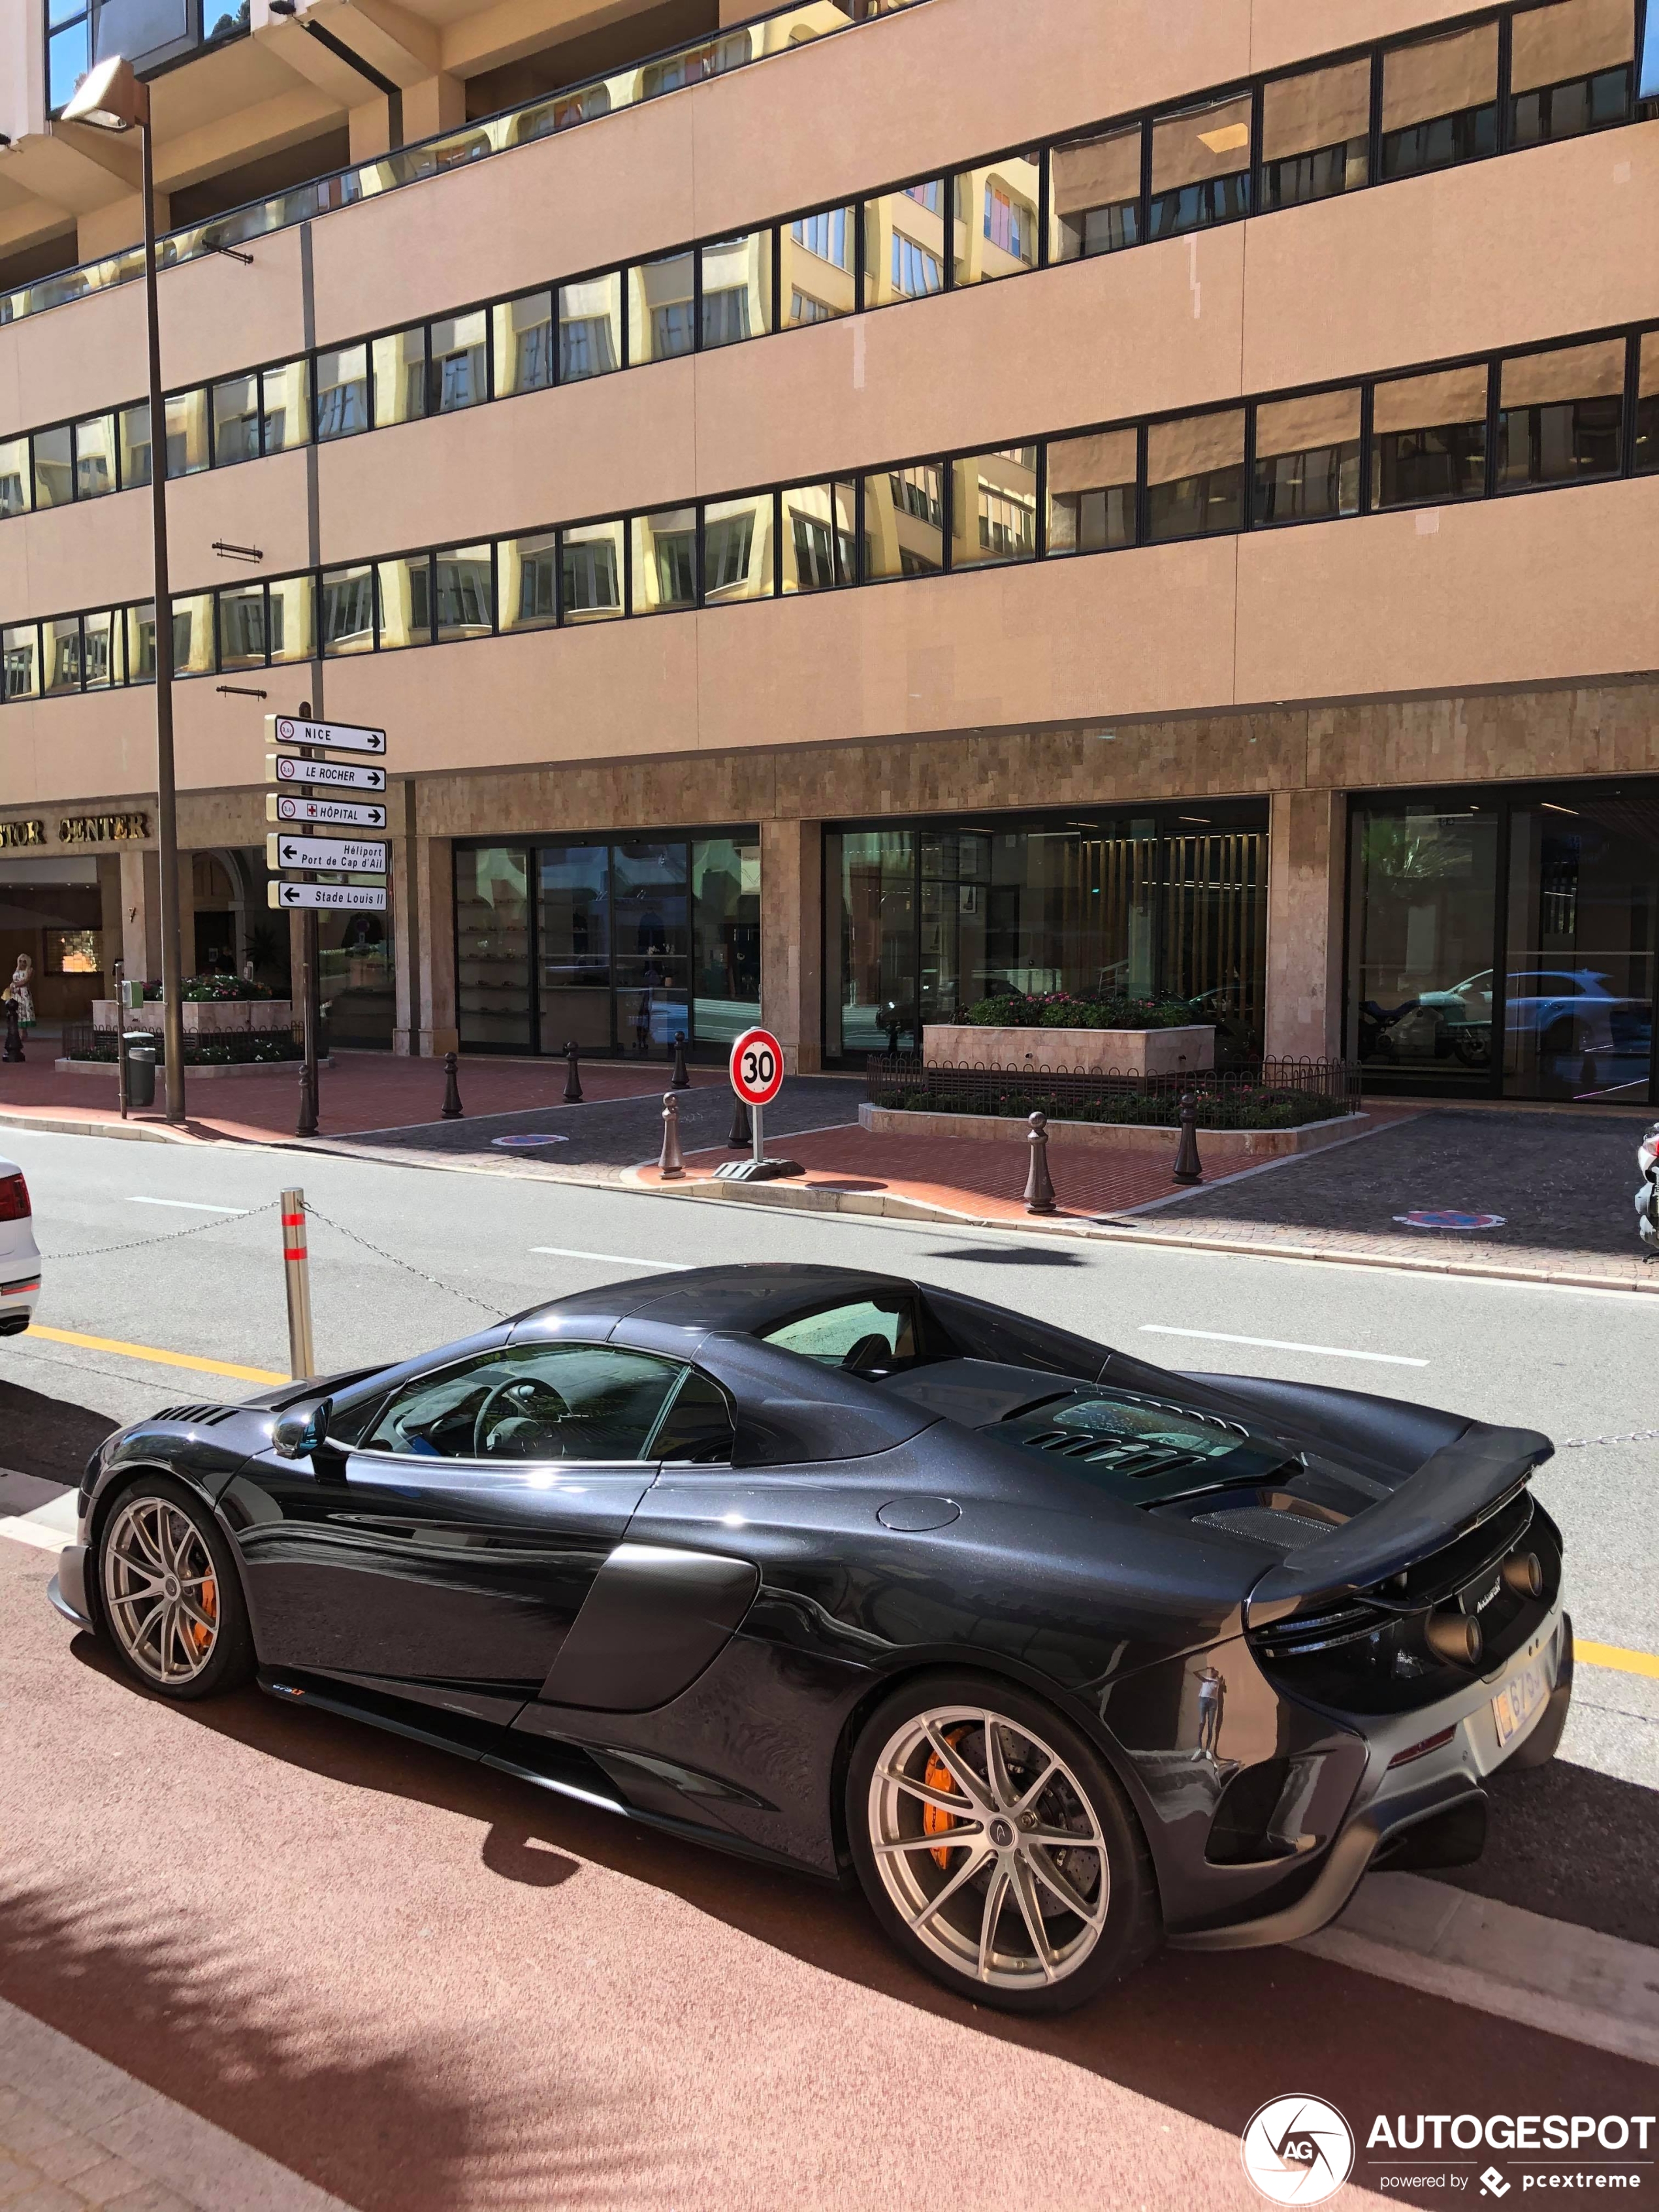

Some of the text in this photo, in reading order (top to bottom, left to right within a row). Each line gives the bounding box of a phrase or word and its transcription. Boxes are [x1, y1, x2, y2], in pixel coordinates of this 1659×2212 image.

[305, 728, 331, 741] NICE
[306, 767, 355, 781] LE ROCHER
[320, 806, 358, 820] HÔPITAL
[59, 814, 145, 843] CENTER
[344, 845, 382, 858] Héliport
[302, 854, 382, 869] Port de Cap d'Ail
[315, 891, 383, 905] Stade Louis II
[744, 1051, 774, 1083] 30
